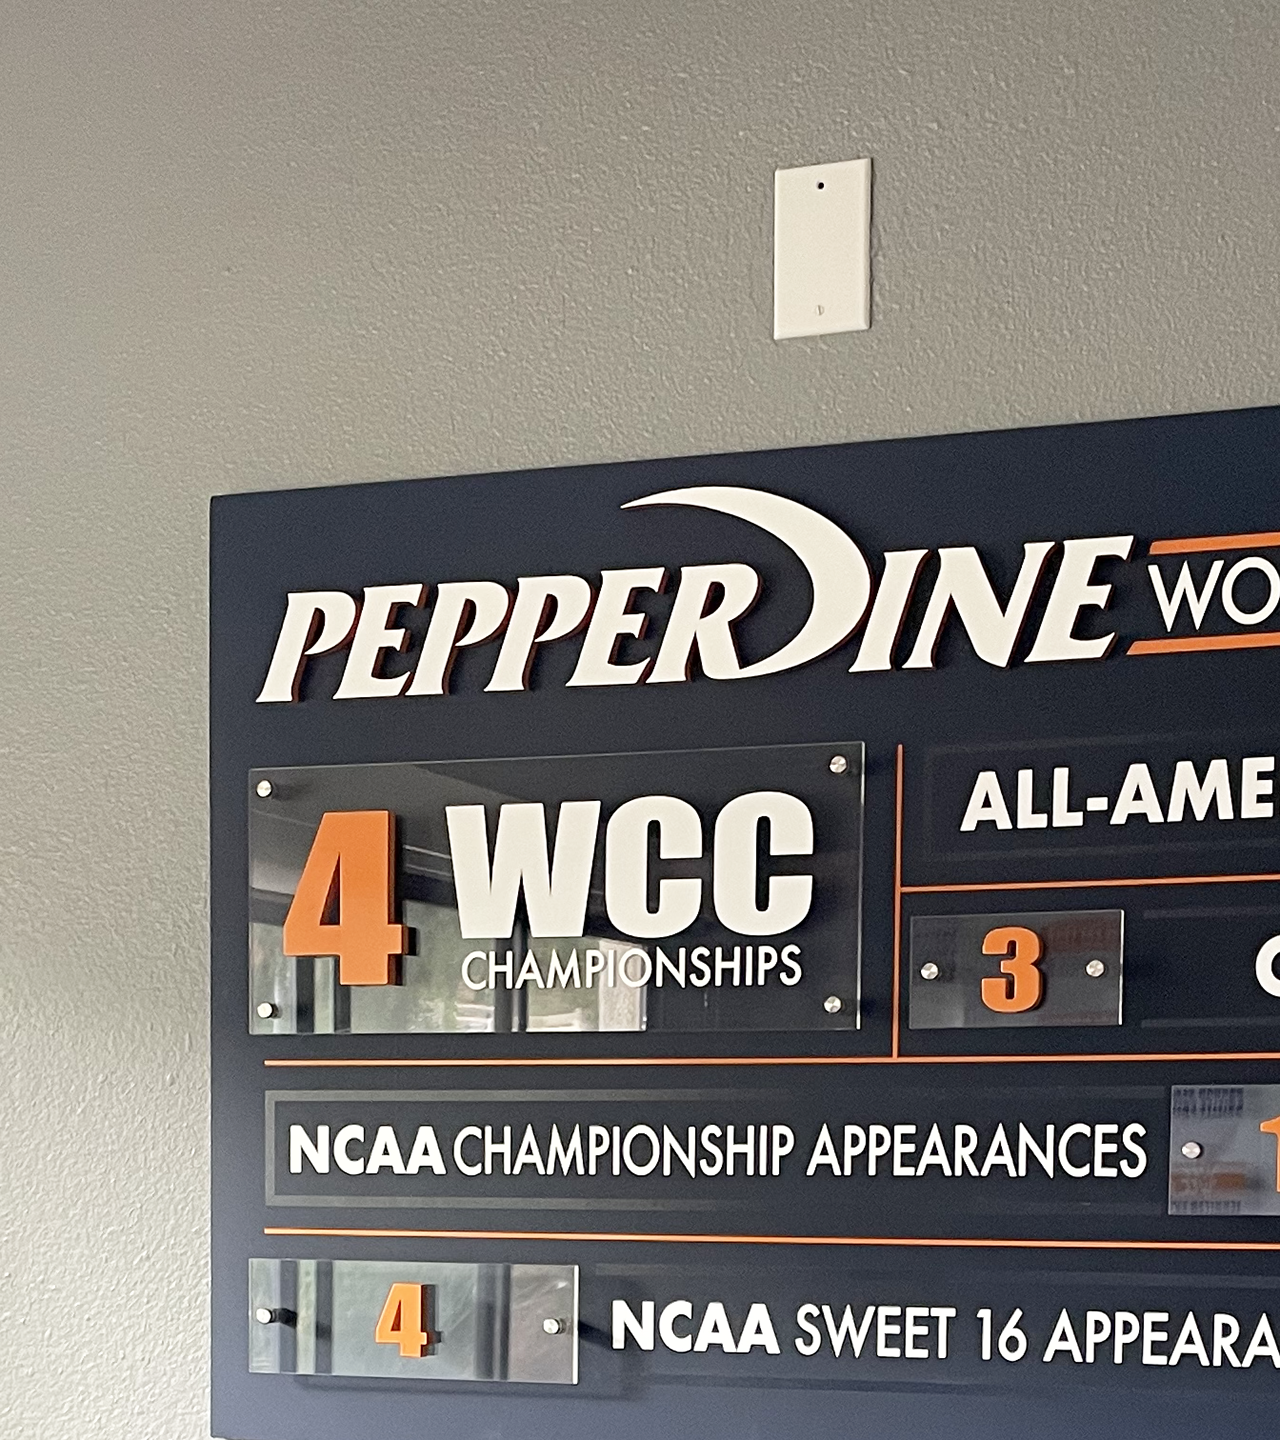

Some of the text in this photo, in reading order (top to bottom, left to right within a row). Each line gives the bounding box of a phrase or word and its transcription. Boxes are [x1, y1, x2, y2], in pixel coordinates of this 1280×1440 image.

[254, 485, 1136, 704] PEPPERDINE
[282, 791, 814, 987] 4 WCC
[461, 944, 803, 992] CHAMPIONSHIPS
[981, 926, 1043, 1014] 3
[288, 1124, 446, 1175] NCAA
[452, 1123, 795, 1179] CHAMPIONSHIP
[806, 1121, 1148, 1179] APPEARANCES
[374, 1281, 429, 1359] 4
[610, 1299, 781, 1355] NCAA
[793, 1303, 957, 1359] SWEET
[975, 1305, 1026, 1362] 16
